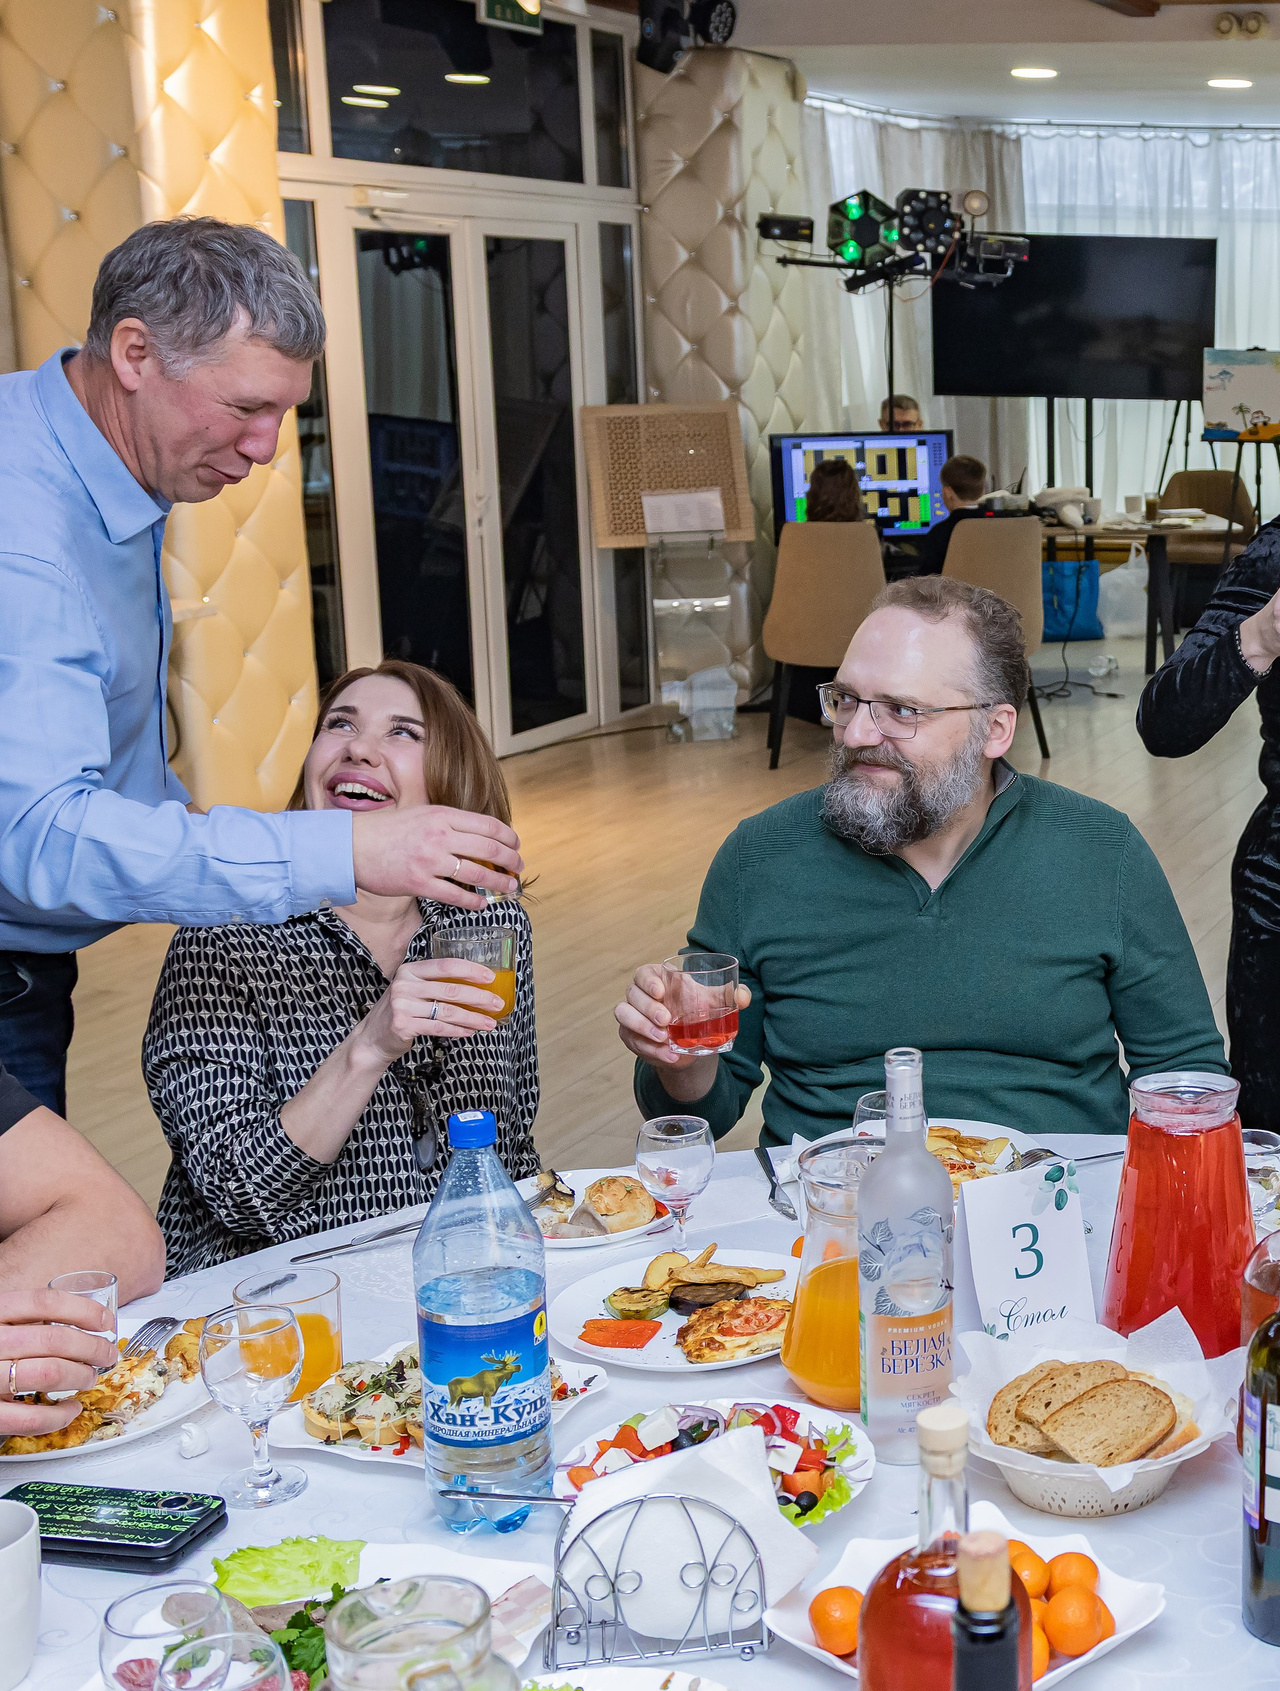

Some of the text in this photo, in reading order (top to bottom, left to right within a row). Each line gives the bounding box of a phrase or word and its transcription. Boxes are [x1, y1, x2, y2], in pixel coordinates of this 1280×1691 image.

[1011, 1222, 1044, 1280] 3
[887, 1318, 948, 1334] PREMIUM VODKA
[998, 1296, 1069, 1332] Стол
[890, 1331, 946, 1357] БЕЛАЯ
[880, 1348, 952, 1375] БЕРЁЗКА
[900, 1395, 942, 1409] МЯГКОСТИ
[906, 1390, 936, 1401] СЕКРЕТ
[428, 1394, 548, 1428] Хан-Куль
[471, 1416, 537, 1438] МИНЕРАЛЬНАЯ
